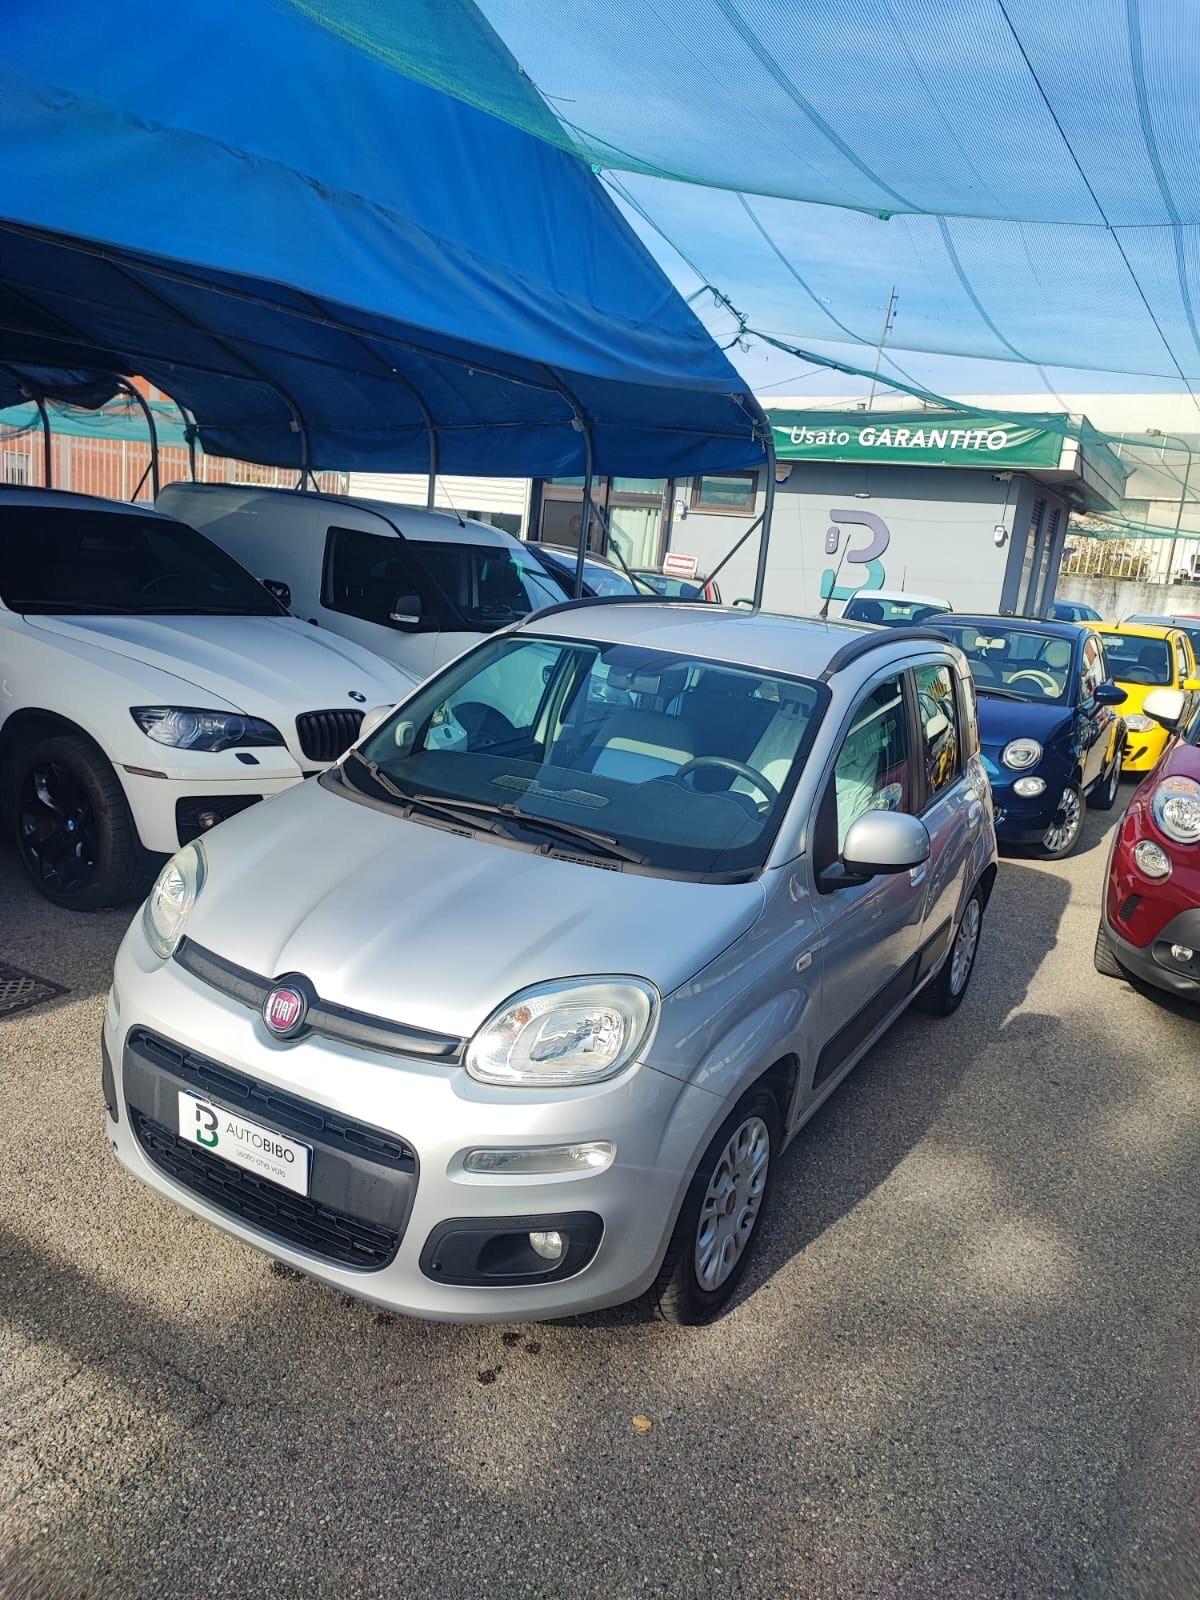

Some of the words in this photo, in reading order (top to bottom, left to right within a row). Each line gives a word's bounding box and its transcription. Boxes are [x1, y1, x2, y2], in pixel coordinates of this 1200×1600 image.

[791, 426, 850, 446] Usato
[858, 427, 1008, 450] GARANTITO
[272, 997, 295, 1022] FIAT
[226, 1122, 295, 1163] AUTOBIBO
